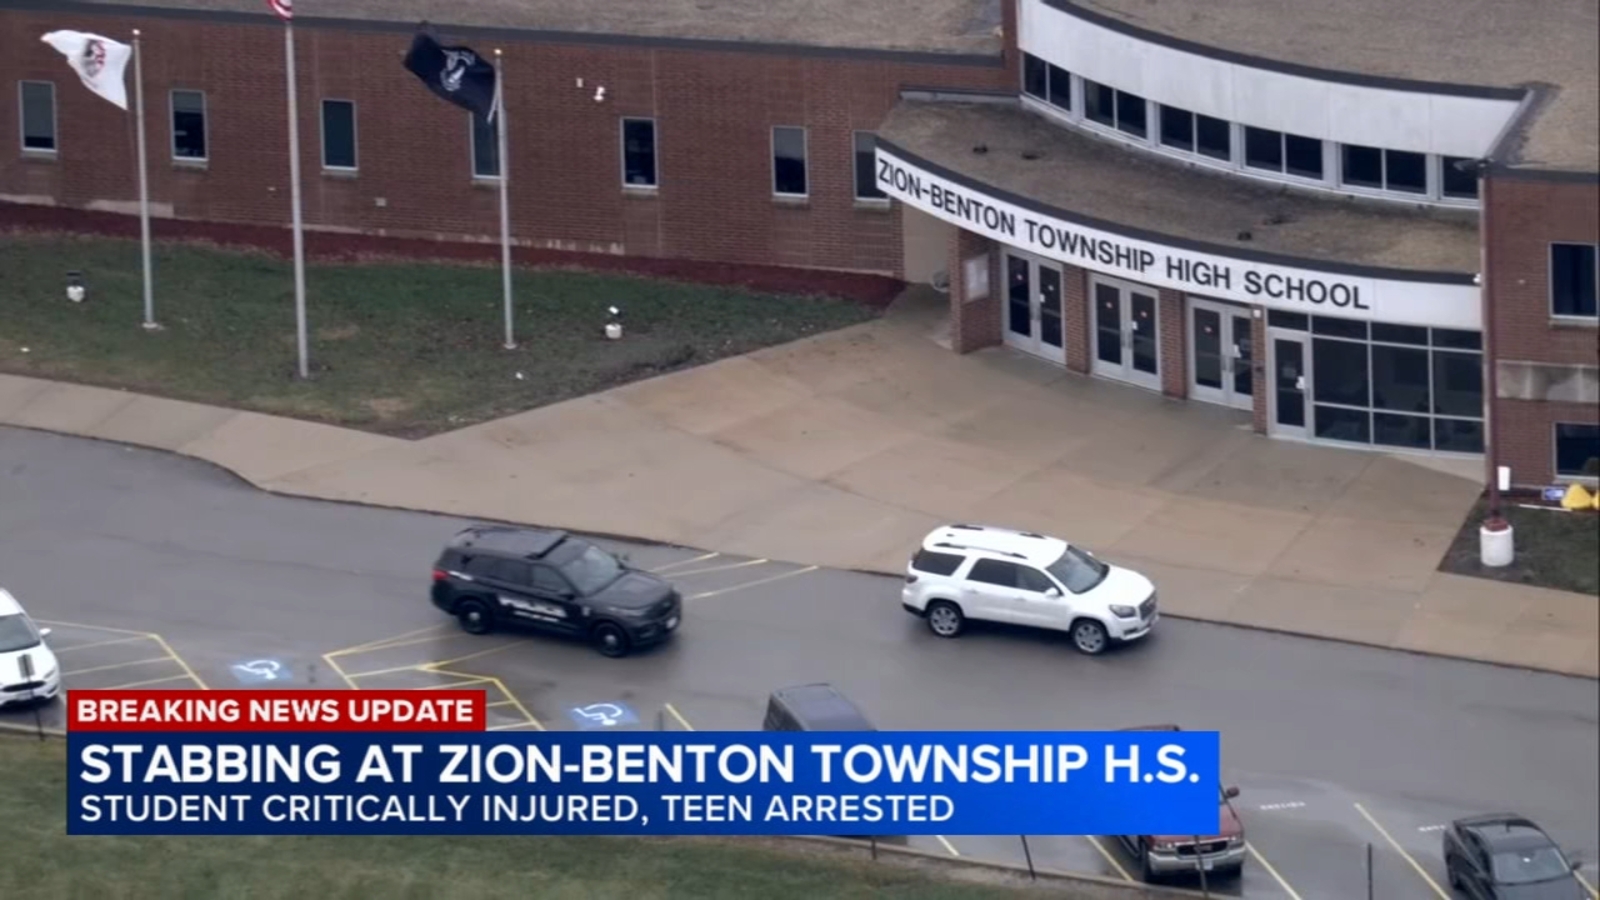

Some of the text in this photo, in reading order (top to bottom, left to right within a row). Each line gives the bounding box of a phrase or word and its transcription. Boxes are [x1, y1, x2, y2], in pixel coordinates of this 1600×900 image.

[877, 157, 1370, 310] ZION-BENTON TOWNSHIP HIGH SCHOOL
